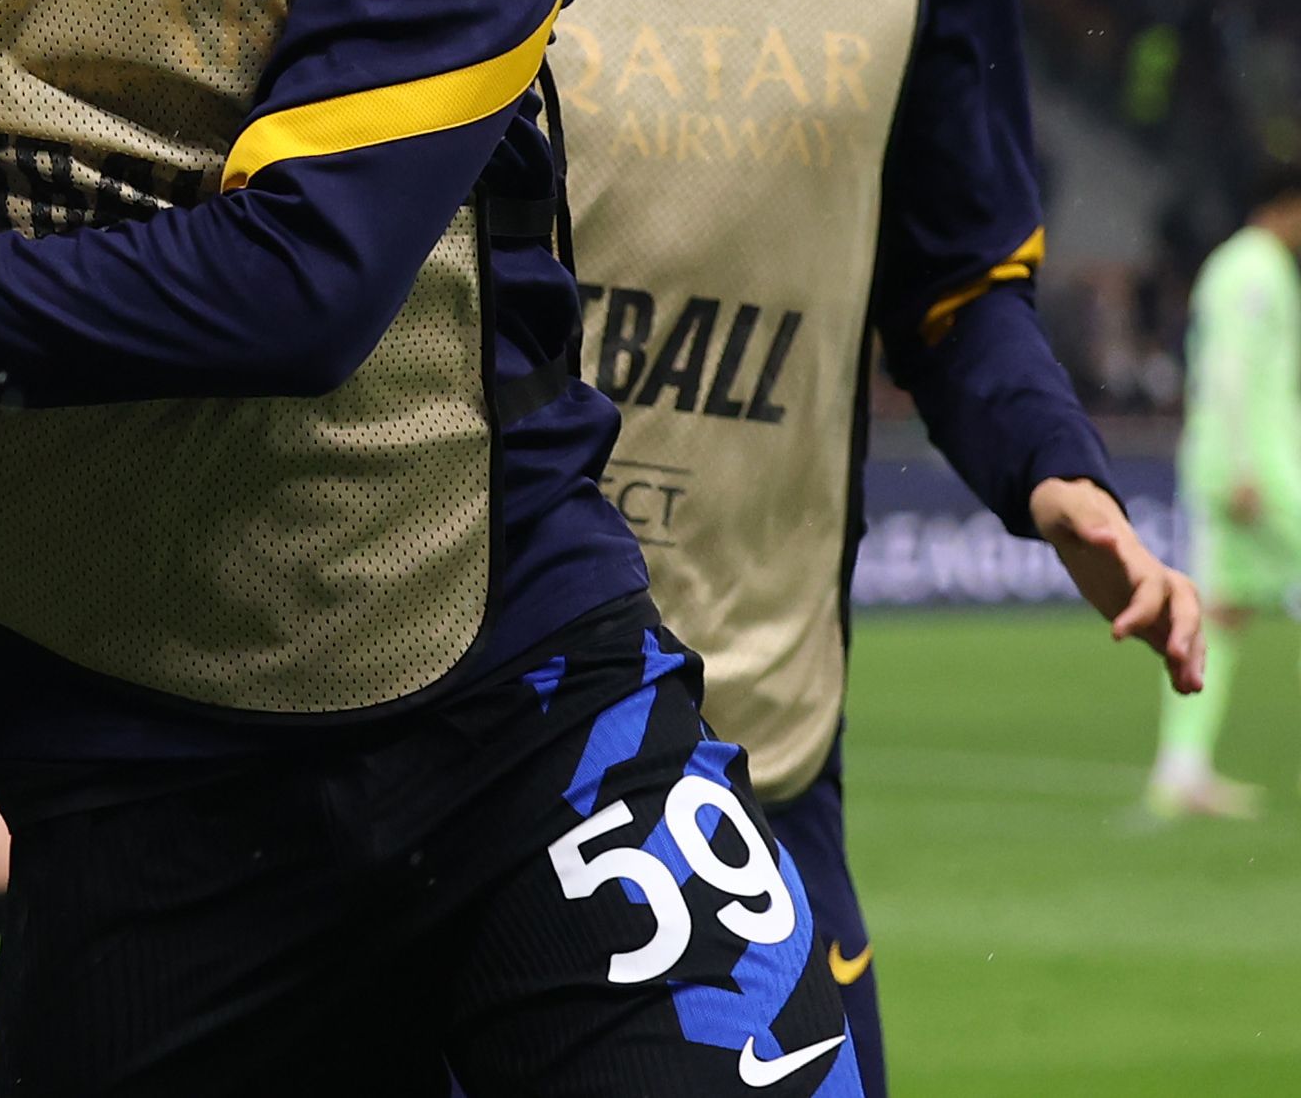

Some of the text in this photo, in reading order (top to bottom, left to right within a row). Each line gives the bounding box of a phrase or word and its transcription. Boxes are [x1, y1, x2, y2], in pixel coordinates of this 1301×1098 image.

[555, 22, 872, 113] QATAR
[612, 110, 837, 168] AIRWAY
[548, 775, 796, 984] 59
